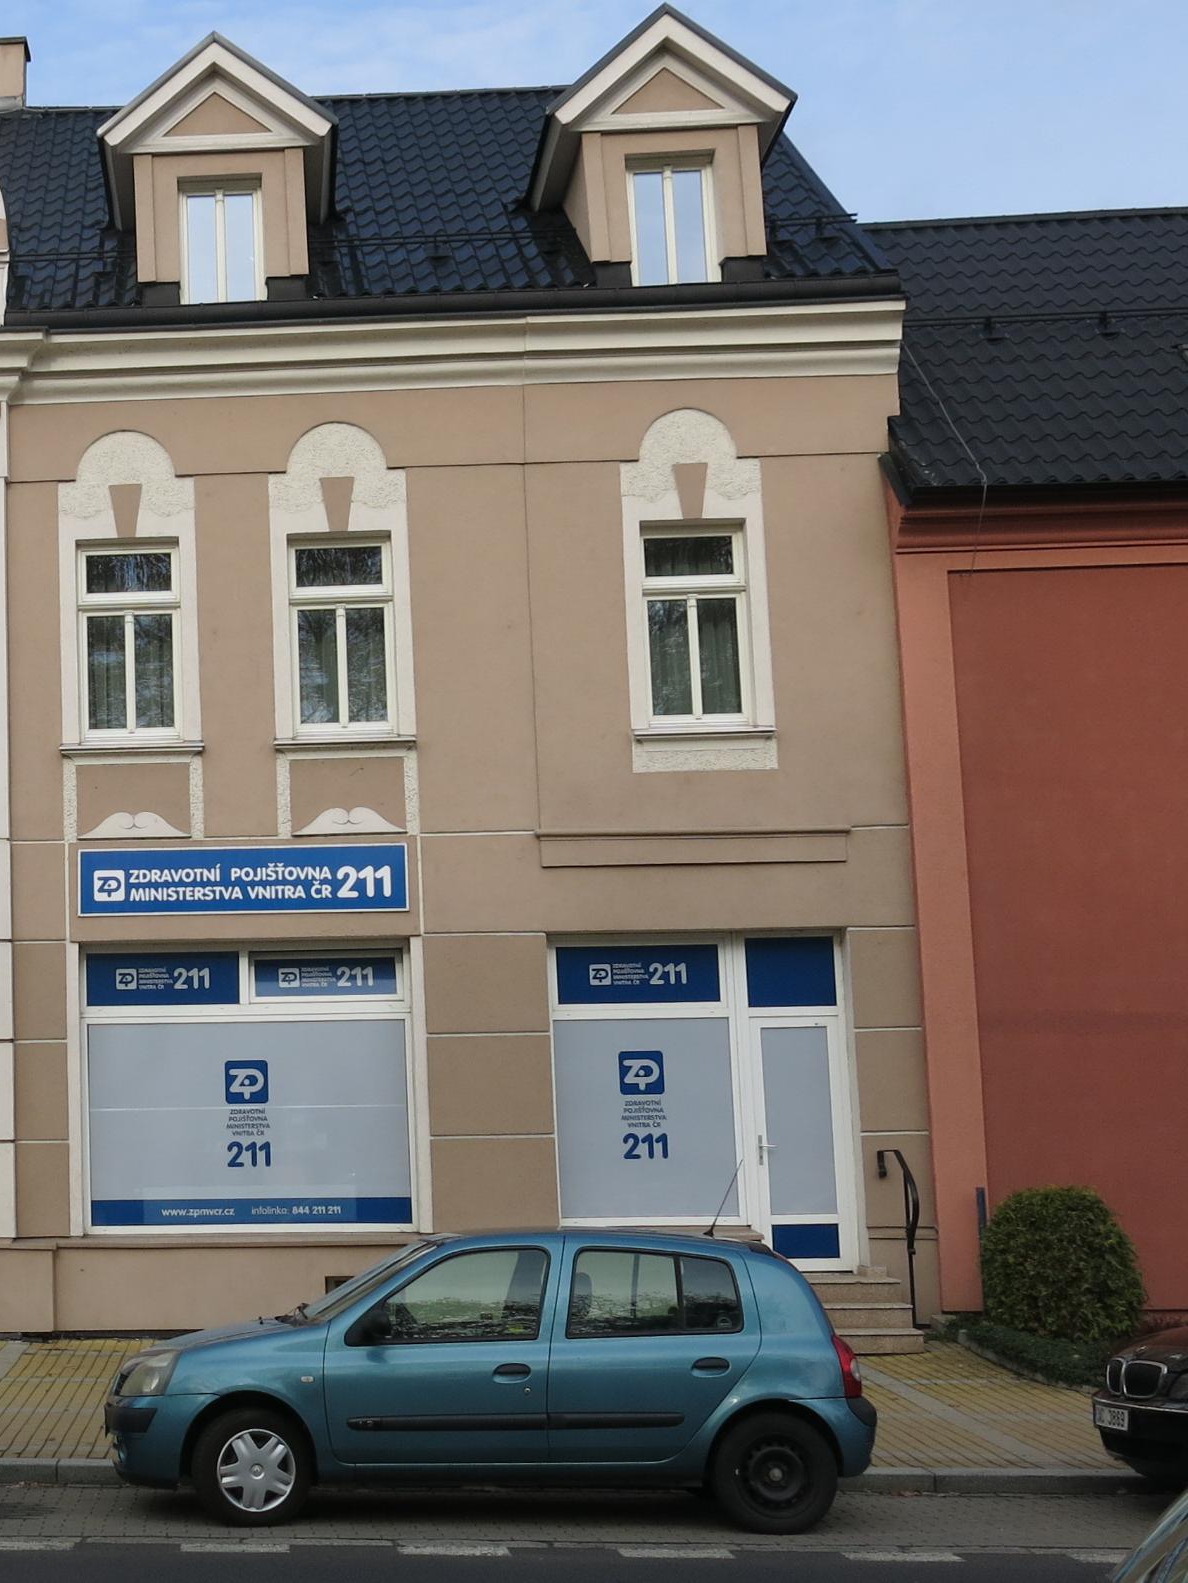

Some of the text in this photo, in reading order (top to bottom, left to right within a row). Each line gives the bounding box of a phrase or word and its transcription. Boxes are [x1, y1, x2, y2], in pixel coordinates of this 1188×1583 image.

[129, 862, 332, 883] ZDRAVOTNÍ POJIŠŤOVNA
[336, 865, 392, 898] 211
[129, 880, 332, 902] MINISTERSTVA VNITRA ČR
[173, 967, 210, 990] 211
[336, 966, 374, 987] 211
[649, 962, 687, 985] 211
[227, 1141, 271, 1168] 211
[622, 1132, 669, 1160] 211
[161, 1205, 342, 1218] www.zpmvcr.cz infolinka: 844 211 211
